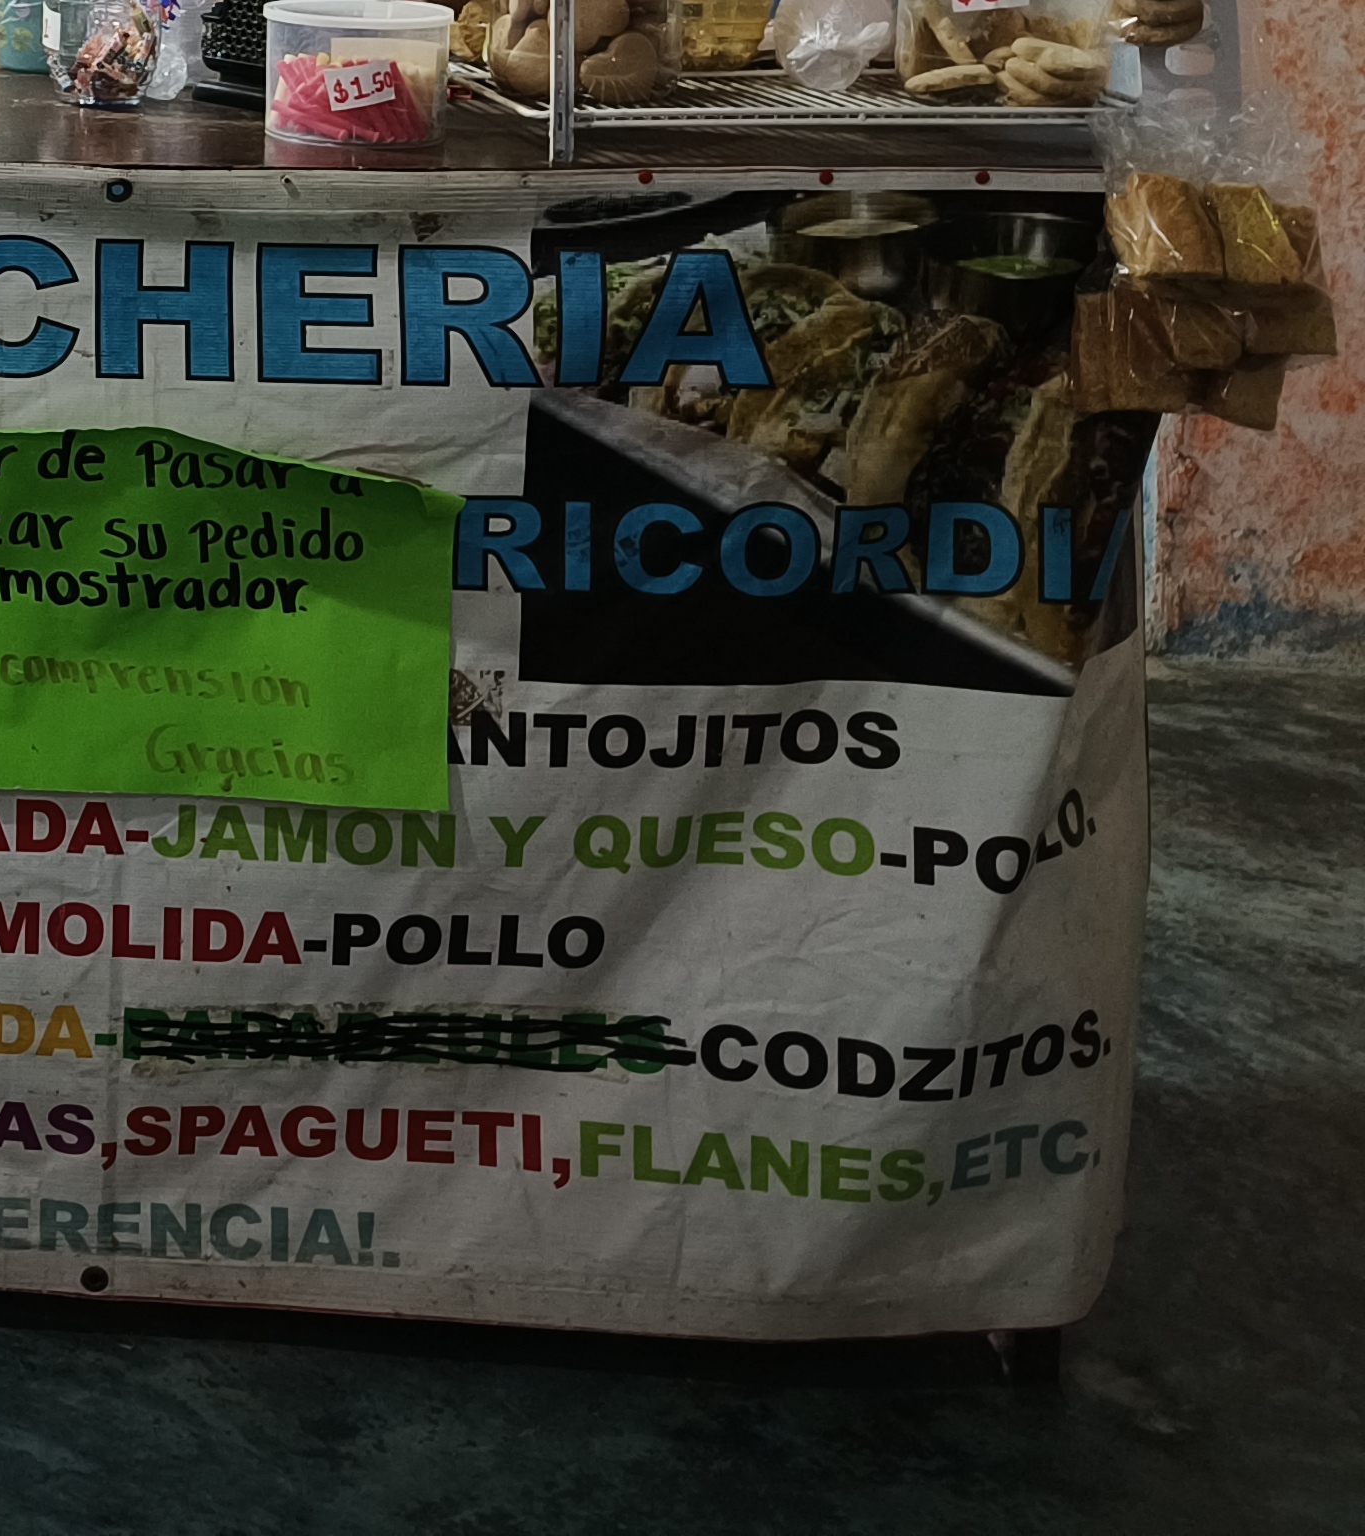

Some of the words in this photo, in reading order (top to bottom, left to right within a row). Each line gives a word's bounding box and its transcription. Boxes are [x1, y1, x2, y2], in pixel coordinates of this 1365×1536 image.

[333, 70, 394, 104] $1.50
[36, 429, 107, 483] de
[329, 474, 364, 498] a
[455, 495, 1129, 605] RICORDI
[145, 722, 356, 788] Gracias
[449, 709, 902, 770] NTOJITOS
[488, 814, 547, 870] Y
